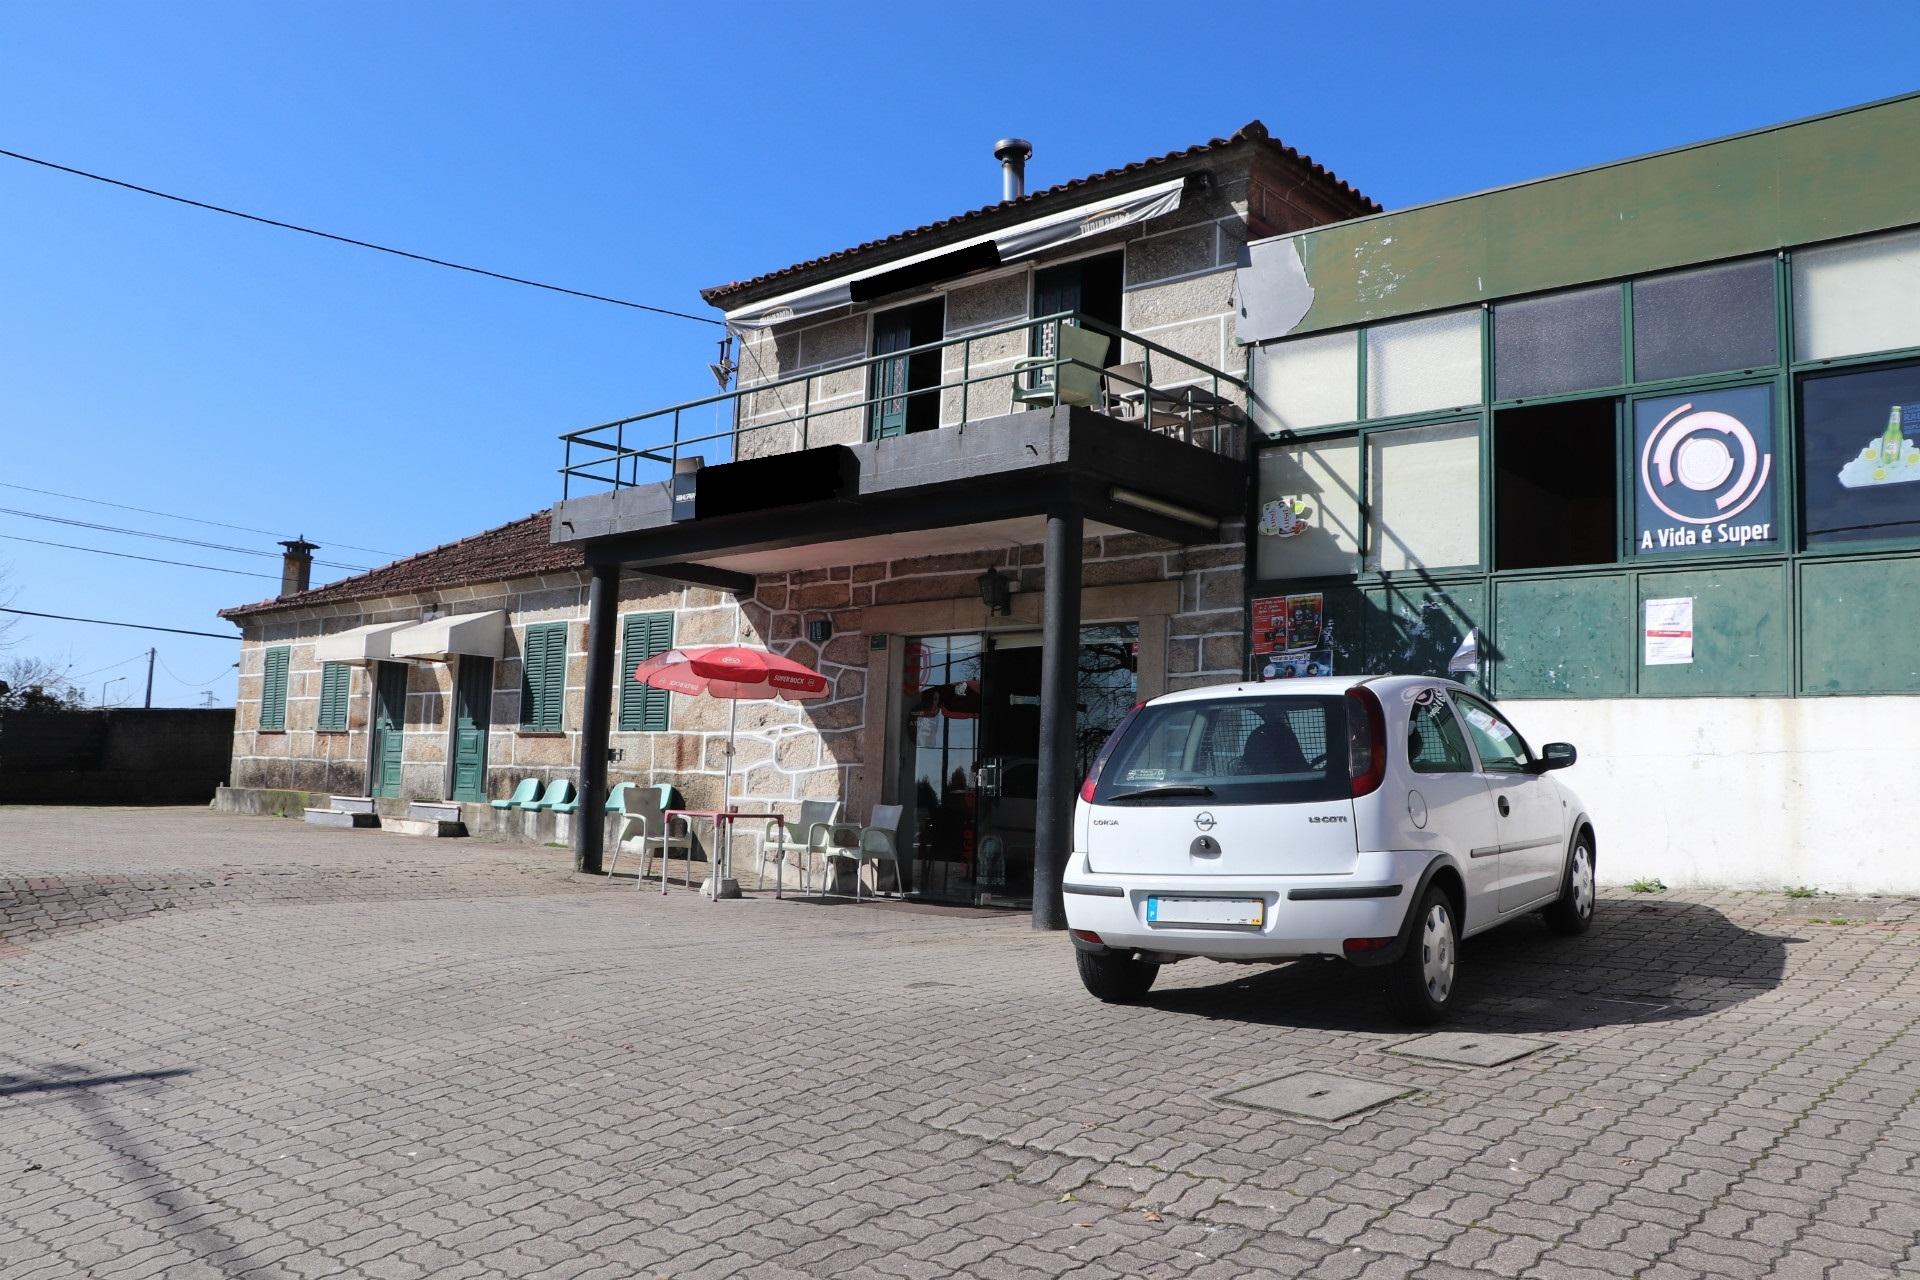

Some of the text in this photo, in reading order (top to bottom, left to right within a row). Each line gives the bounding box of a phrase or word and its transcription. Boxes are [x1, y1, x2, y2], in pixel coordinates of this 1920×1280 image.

[1641, 523, 1770, 549] A Vida é Super
